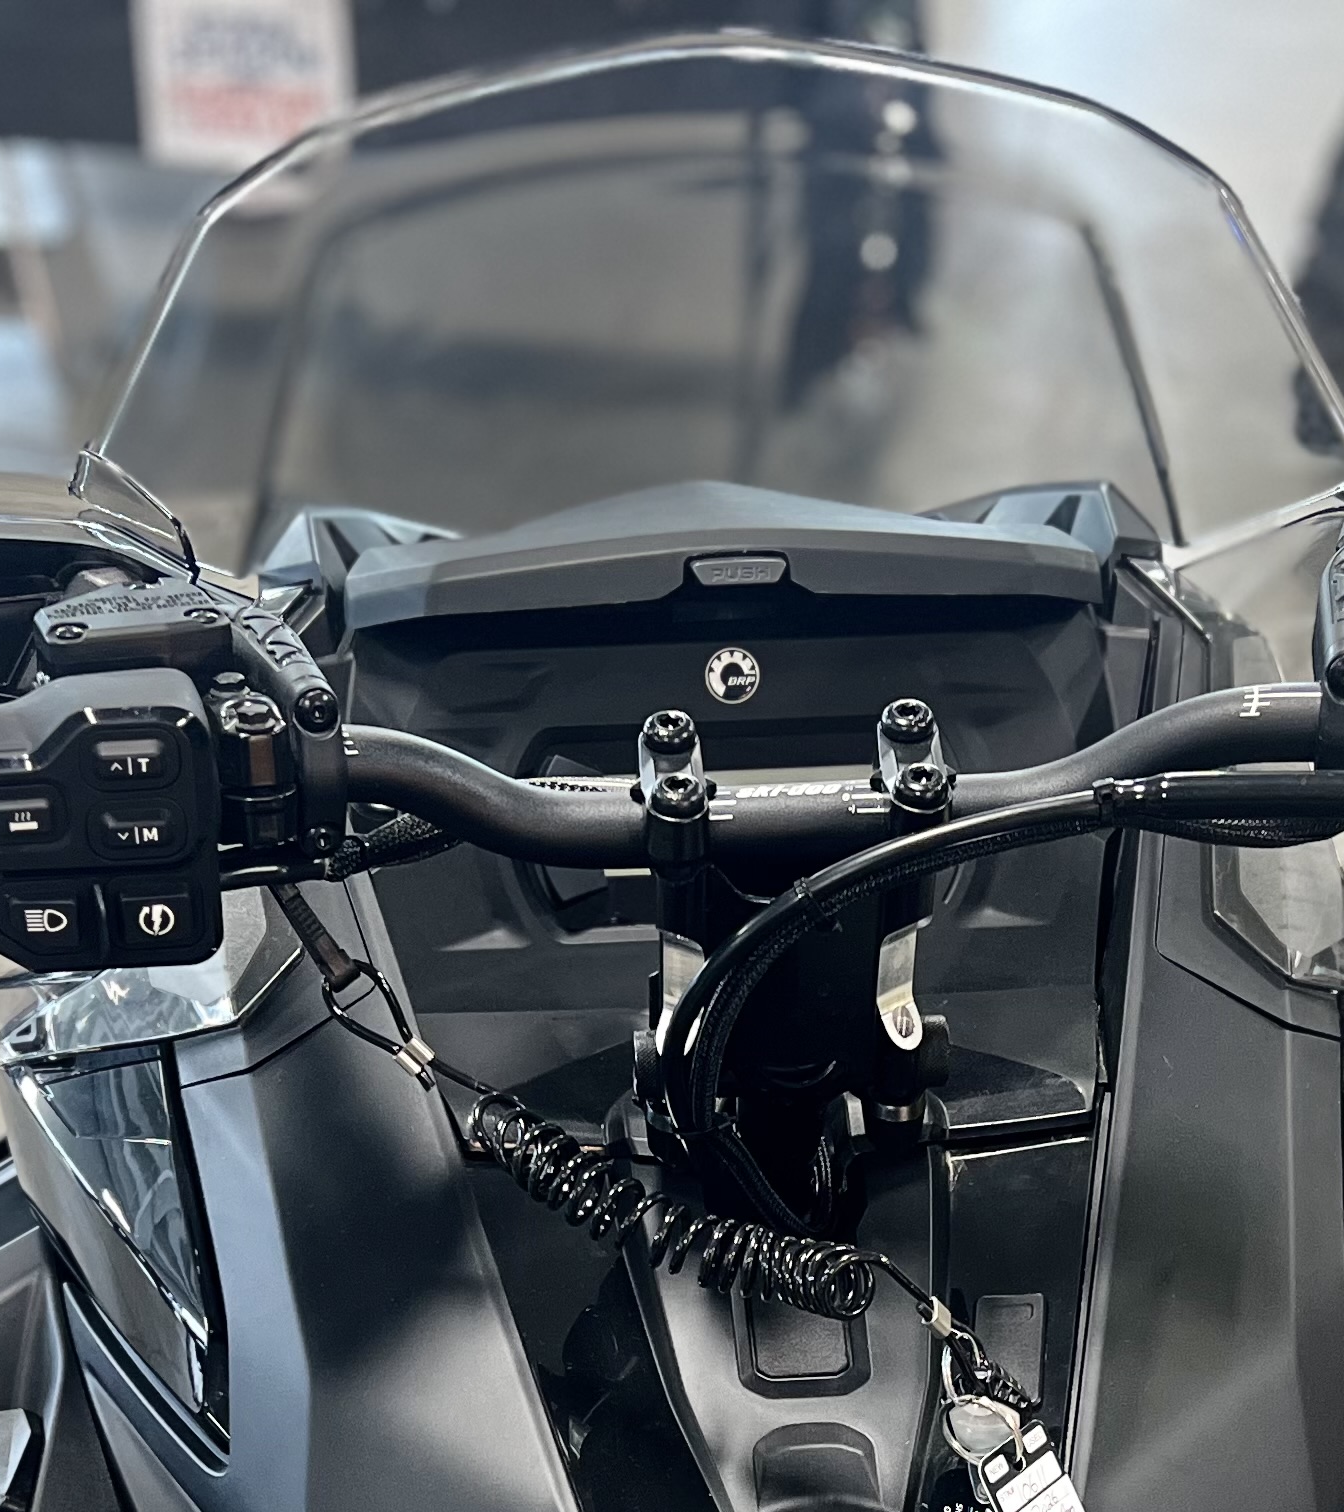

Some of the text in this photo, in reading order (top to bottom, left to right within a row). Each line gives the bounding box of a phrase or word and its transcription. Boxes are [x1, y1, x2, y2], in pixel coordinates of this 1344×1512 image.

[712, 567, 770, 582] PUSH
[728, 676, 755, 685] BRP
[137, 758, 149, 772] T
[143, 827, 158, 841] M
